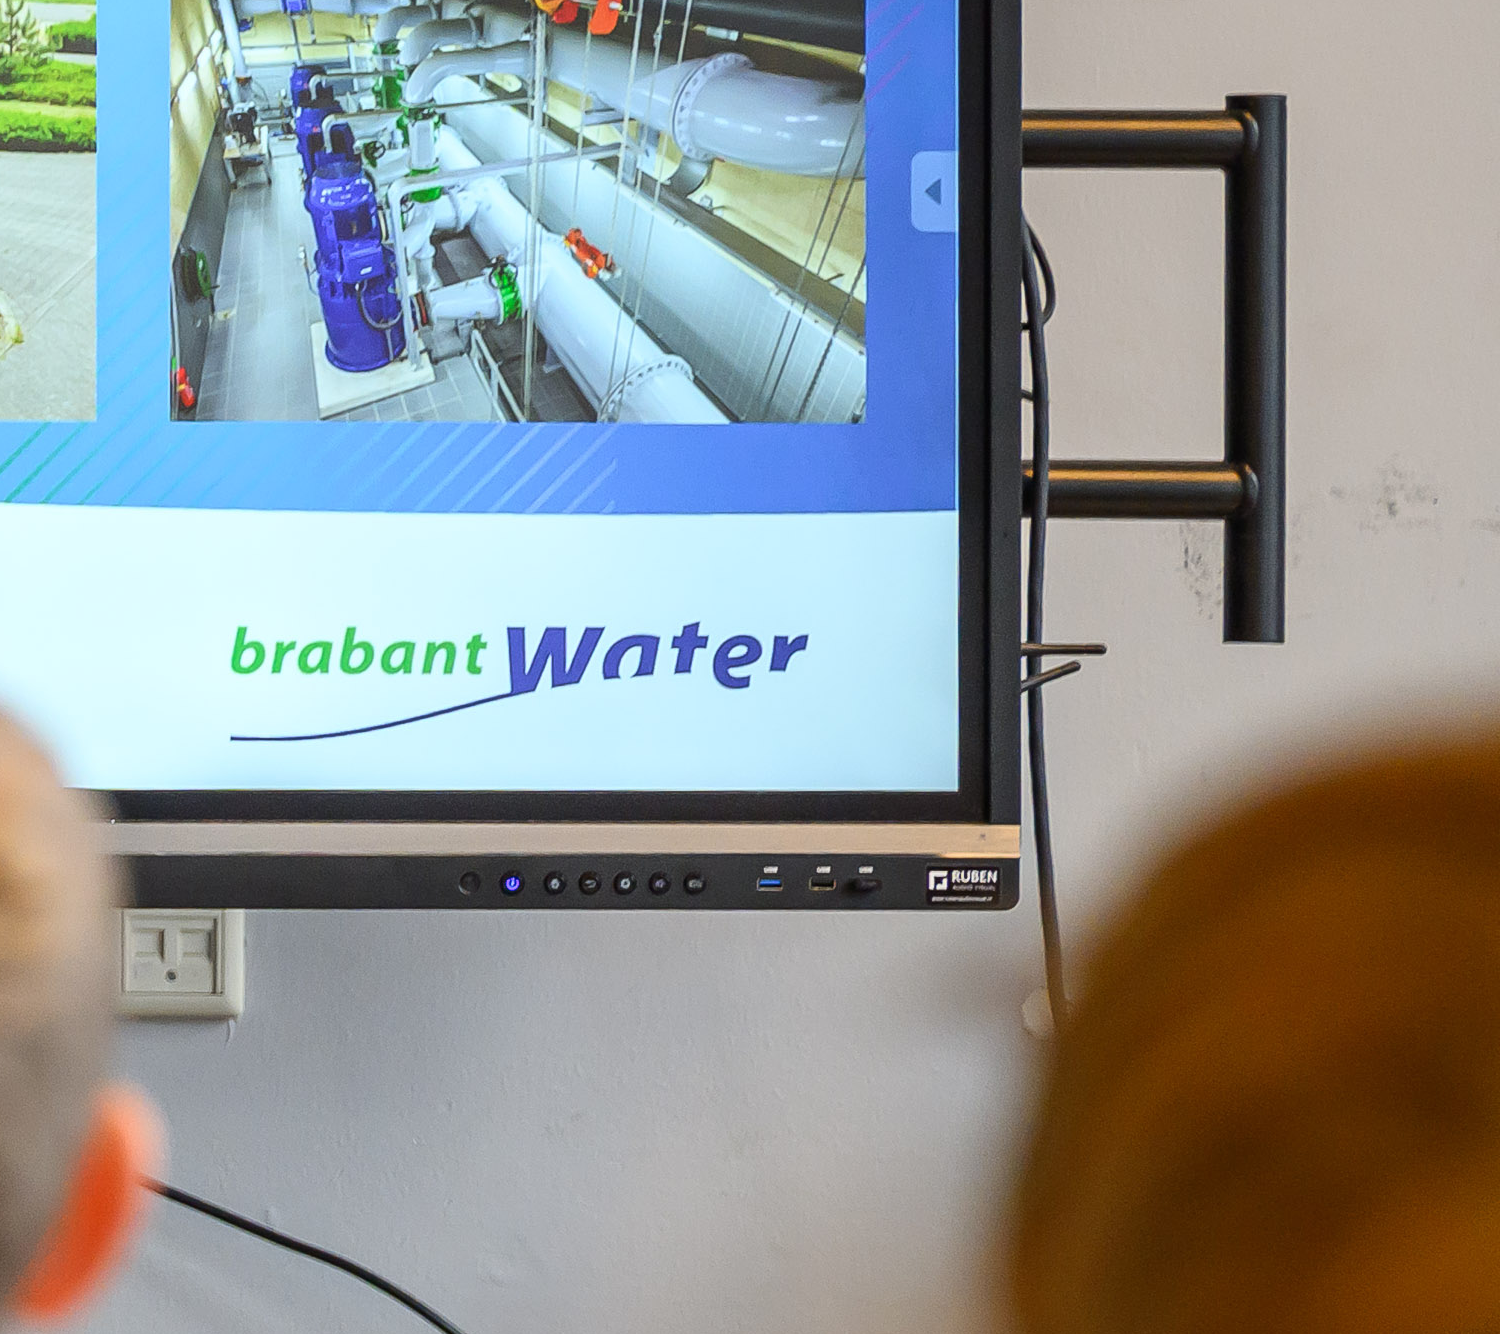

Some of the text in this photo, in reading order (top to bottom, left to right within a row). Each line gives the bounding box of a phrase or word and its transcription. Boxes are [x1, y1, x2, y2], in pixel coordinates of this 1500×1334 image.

[230, 620, 810, 695] brabant Water
[951, 869, 998, 884] RUBEN
